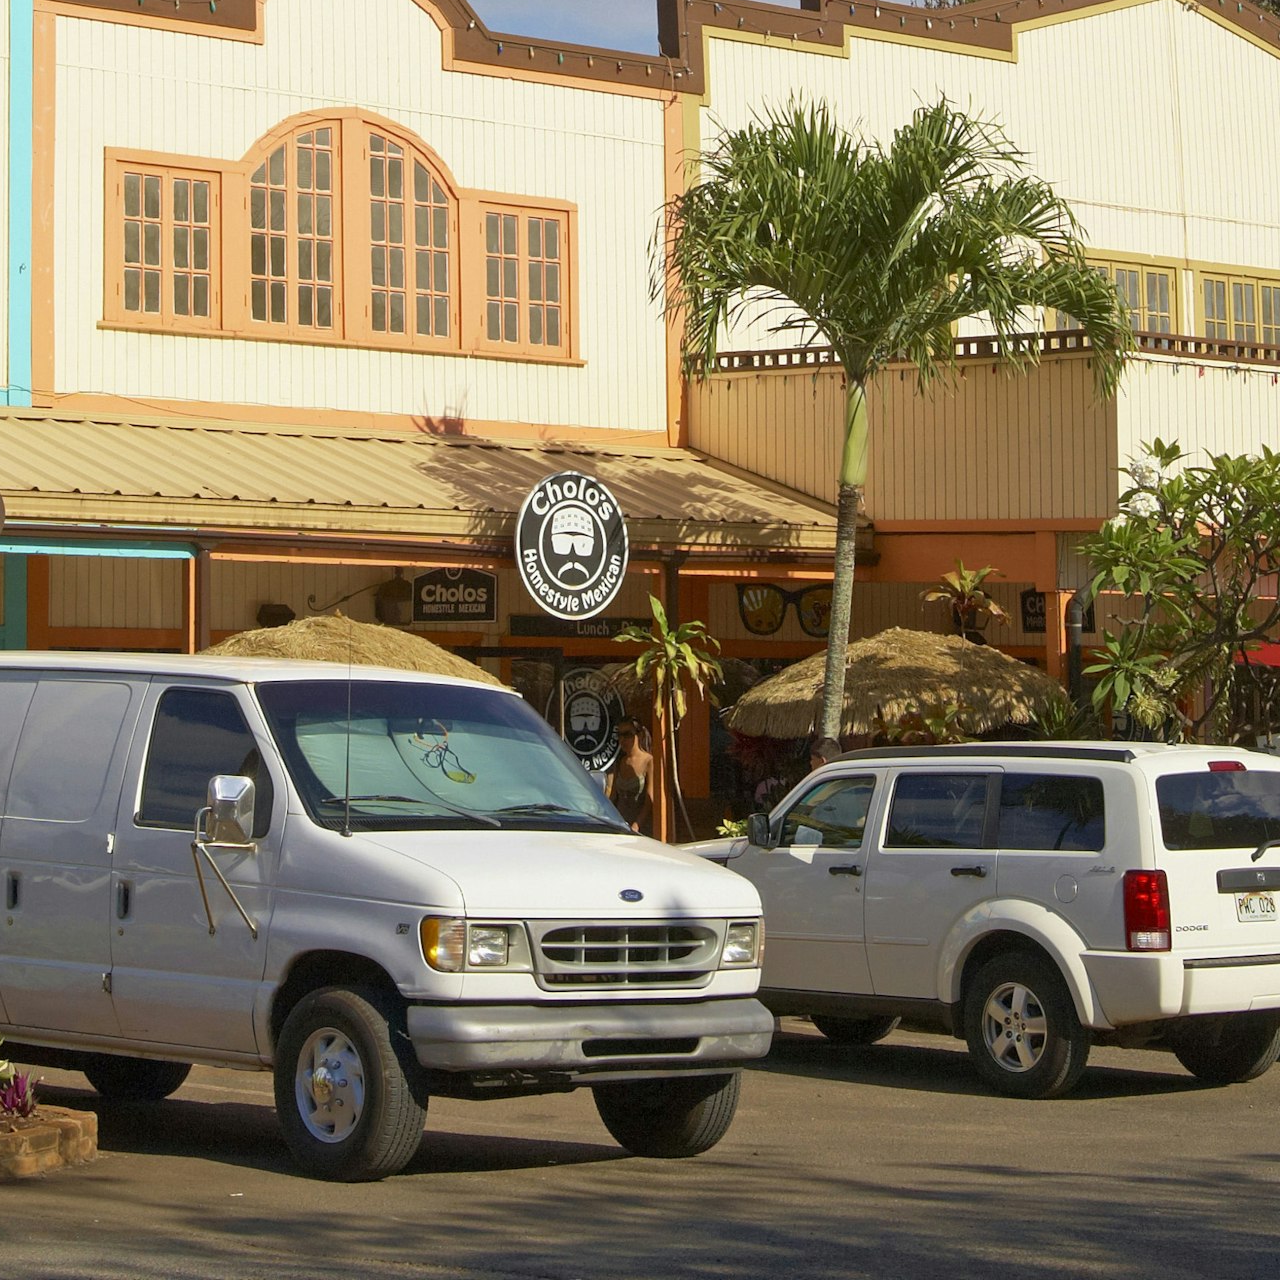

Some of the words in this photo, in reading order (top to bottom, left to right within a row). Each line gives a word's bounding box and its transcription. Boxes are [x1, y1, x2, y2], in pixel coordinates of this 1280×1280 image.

[531, 478, 614, 521] Cholo's
[523, 548, 580, 612] Homestyle
[581, 554, 623, 610] Mexican
[421, 583, 487, 603] Cholos
[422, 603, 455, 614] HOMESTYLE
[458, 603, 486, 614] MEXICAN
[576, 620, 609, 636] Lunch
[1259, 897, 1276, 913] 028
